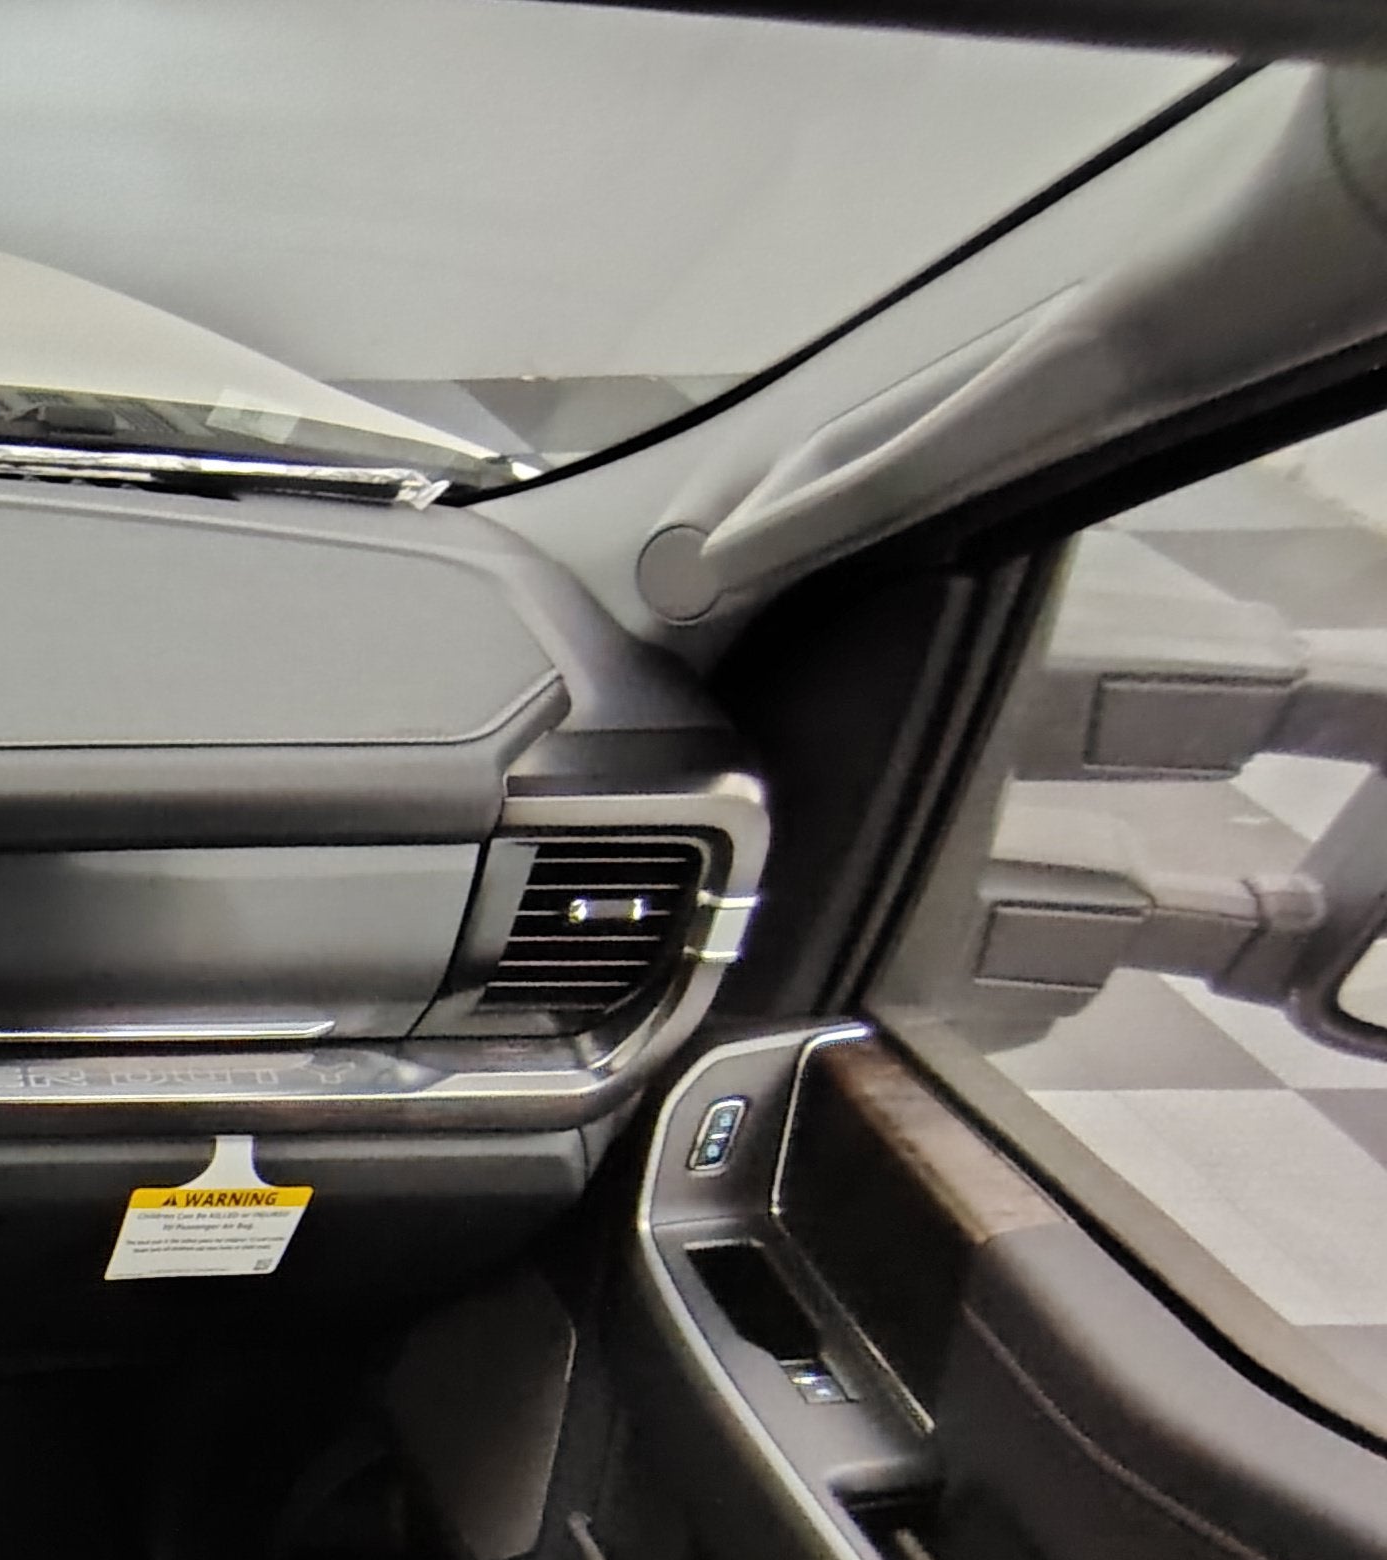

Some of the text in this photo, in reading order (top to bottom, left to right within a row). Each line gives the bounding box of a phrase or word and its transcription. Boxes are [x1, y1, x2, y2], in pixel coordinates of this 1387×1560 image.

[184, 1192, 277, 1207] WARNING
[137, 1211, 176, 1220] Children
[177, 1211, 194, 1219] Can
[196, 1210, 207, 1219] Be
[209, 1210, 239, 1219] KILLED
[176, 1223, 221, 1232] Passenger
